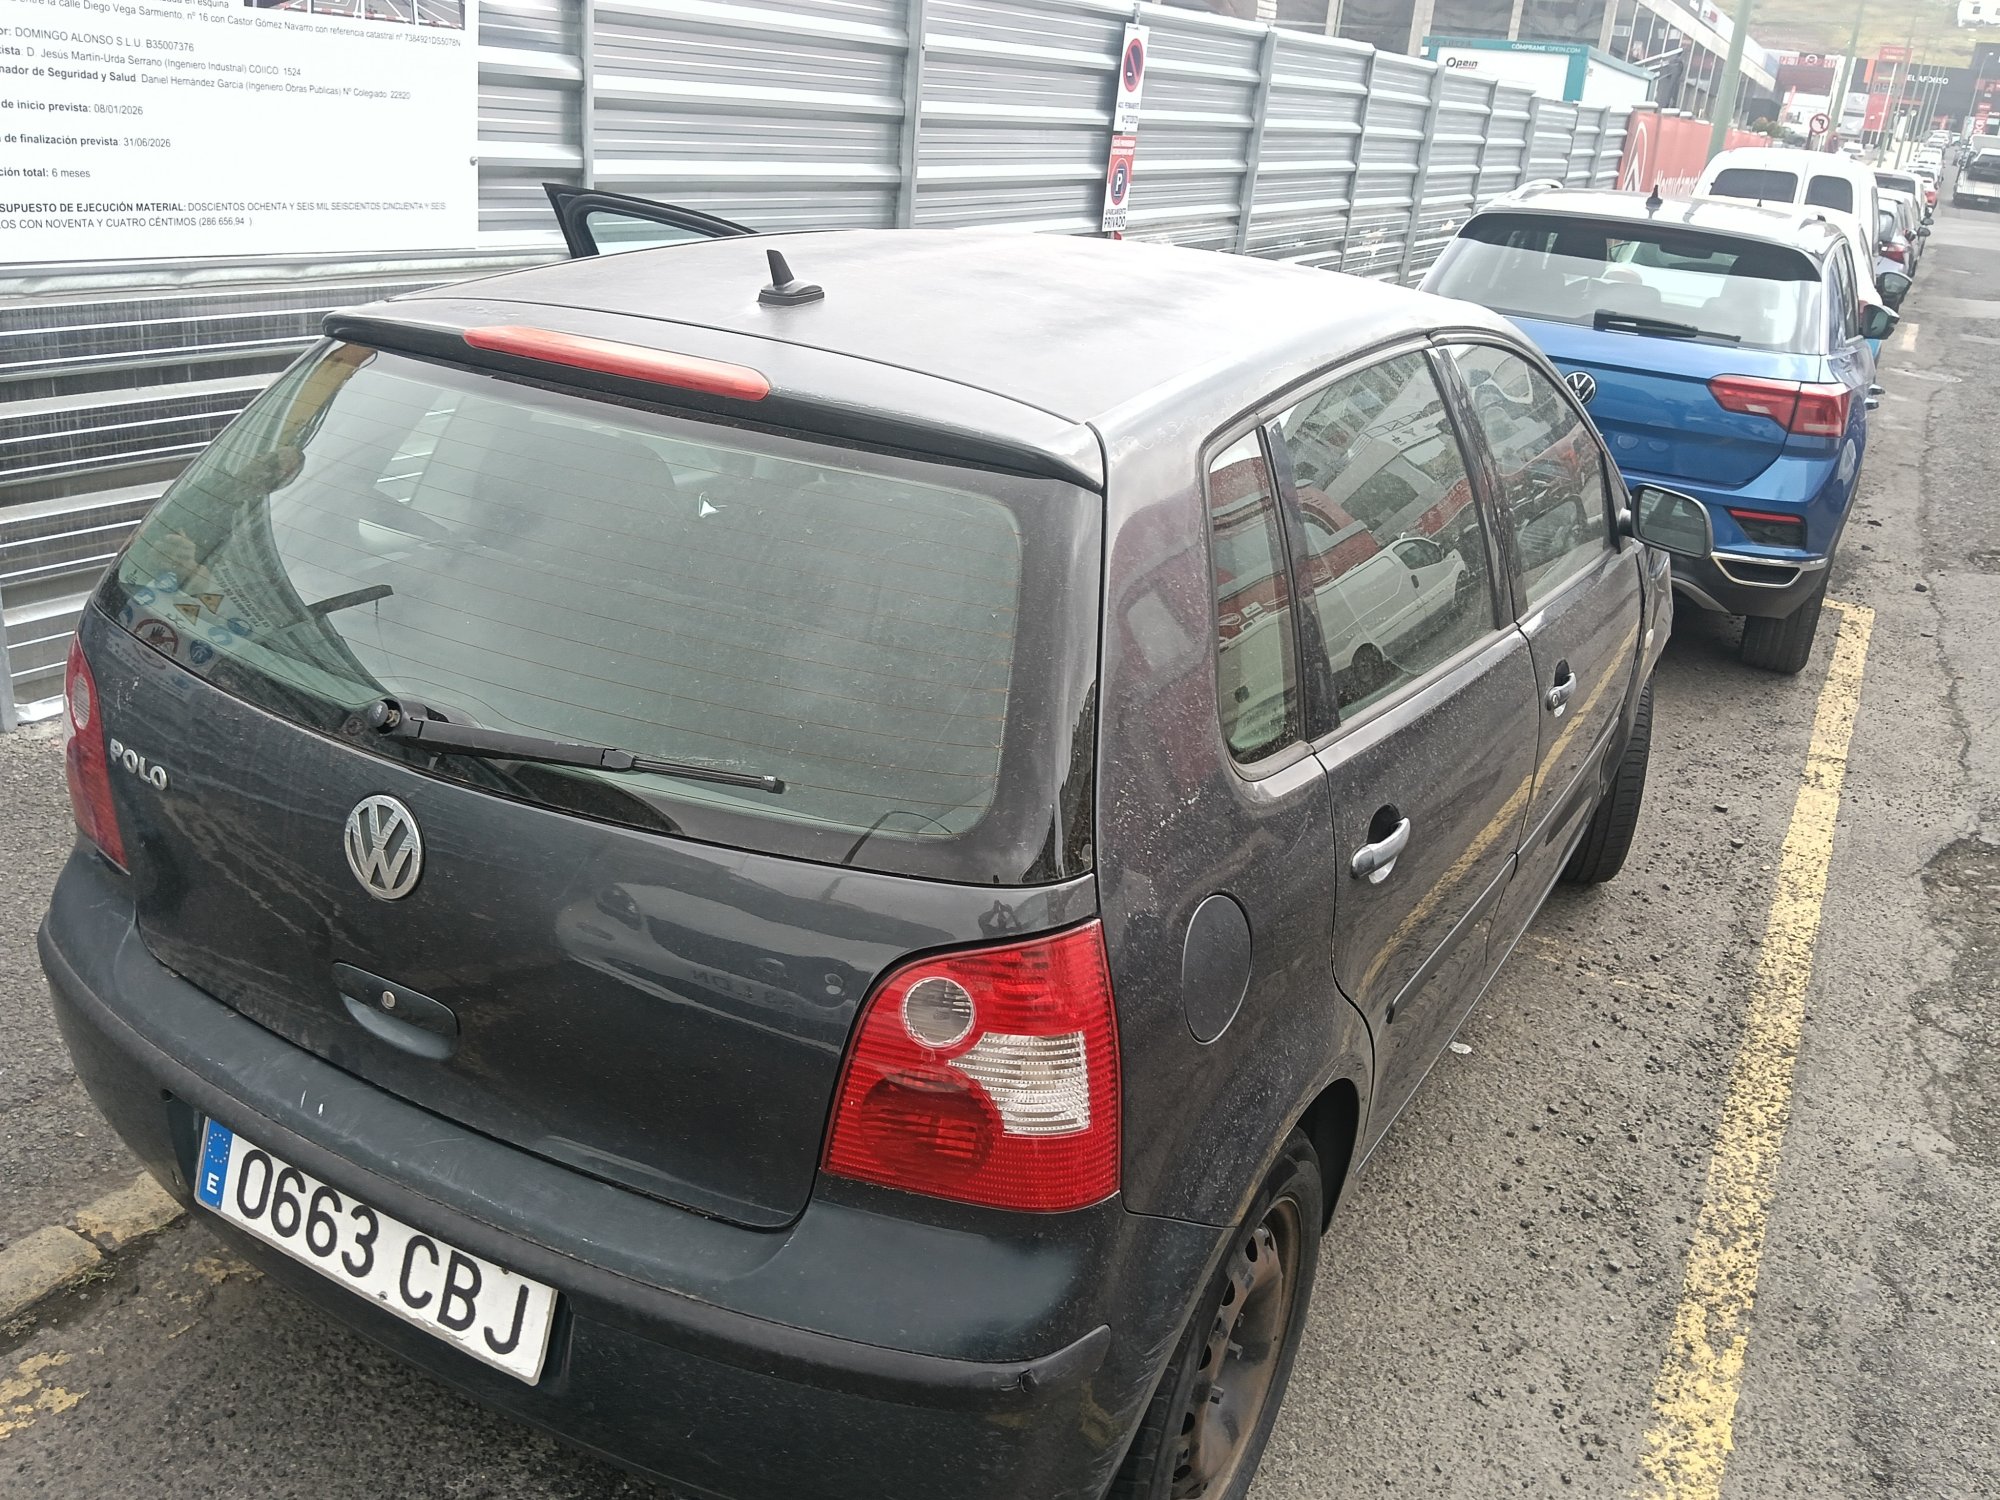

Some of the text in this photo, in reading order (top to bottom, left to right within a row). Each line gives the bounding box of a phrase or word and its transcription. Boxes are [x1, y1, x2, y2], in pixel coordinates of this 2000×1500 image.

[59, 0, 80, 9] calle
[83, 0, 110, 13] Diego
[112, 3, 136, 16] Vega
[198, 12, 208, 21] 16
[210, 15, 225, 24] con
[227, 14, 253, 26] Castor
[255, 17, 282, 30] Gómez
[284, 21, 313, 32] Navarro
[315, 25, 329, 34] con
[329, 26, 365, 38] referencia
[365, 31, 395, 41] catastral
[15, 26, 69, 41] DOMINGO
[71, 32, 114, 45] ALONSO
[146, 39, 194, 52] B35007376
[41, 48, 69, 60] Jesús
[128, 55, 163, 67] Serrano
[164, 58, 206, 71] (Ingeniero
[208, 62, 247, 74] Industrial)
[283, 67, 301, 77] 1524
[1446, 56, 1478, 69] Opein
[32, 66, 45, 76] de
[47, 67, 98, 80] Seguridad
[101, 73, 107, 82] y
[141, 73, 169, 84] Daniel
[170, 76, 215, 88] Hernández
[245, 81, 284, 93] (Ingeniero
[285, 83, 308, 94] Obras
[1, 99, 144, 115] de inicio prevista: 08/01/2026
[4, 133, 17, 143] de
[20, 133, 78, 145] finalización
[123, 137, 171, 147] 31/06/2026
[22, 168, 49, 177] total:
[51, 168, 58, 177] 6
[60, 170, 91, 178] meses
[60, 203, 74, 212] DE
[76, 201, 133, 212] EJECUCIÓN
[136, 203, 186, 212] MATERIAL:
[187, 202, 246, 211] DOSCIENTOS
[247, 202, 287, 211] OCHENTA
[289, 202, 295, 210] Y
[296, 202, 315, 211] SEIS
[316, 202, 330, 211] MIL
[19, 219, 43, 229] CON
[45, 218, 95, 228] NOVENTA
[97, 218, 104, 228] Y
[106, 217, 147, 227] CUATRO
[148, 215, 197, 226] CÉNTIMOS
[1104, 215, 1126, 228] PRIVADO
[109, 737, 168, 791] POLO
[343, 794, 422, 901] VW
[205, 1172, 220, 1195] E
[236, 1149, 530, 1355] 0663 CBJ
